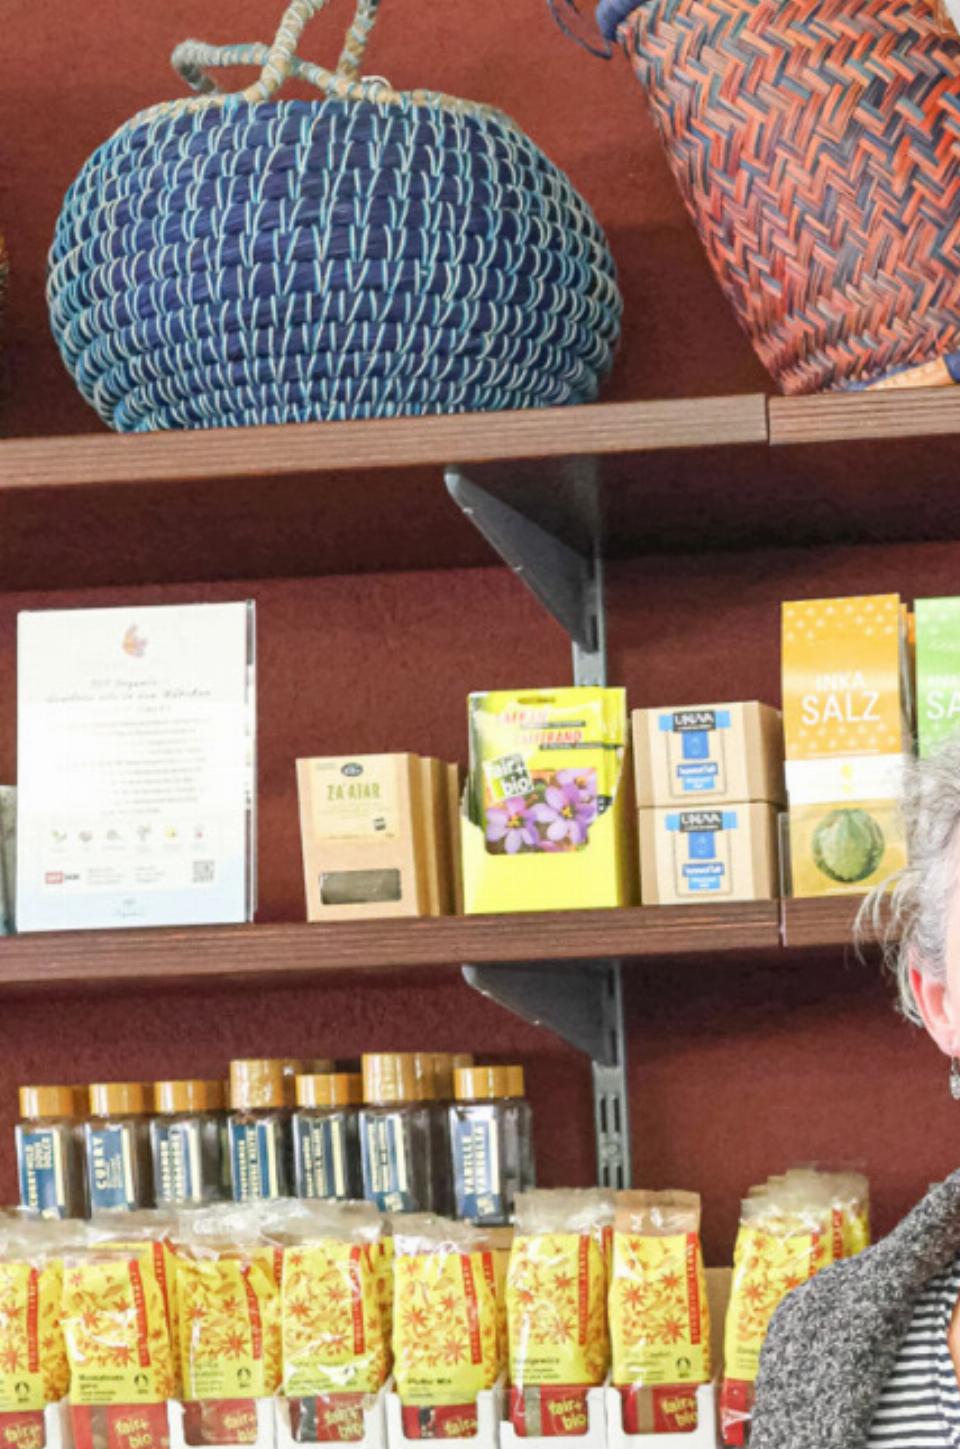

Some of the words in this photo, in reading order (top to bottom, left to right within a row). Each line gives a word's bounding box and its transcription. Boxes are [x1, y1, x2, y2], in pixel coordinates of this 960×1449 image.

[816, 671, 864, 691] INKA
[801, 691, 880, 725] SALZ
[93, 1136, 107, 1189] CURRY
[547, 1399, 583, 1416] fair+
[561, 1414, 587, 1431] bio
[128, 1433, 152, 1449] bio
